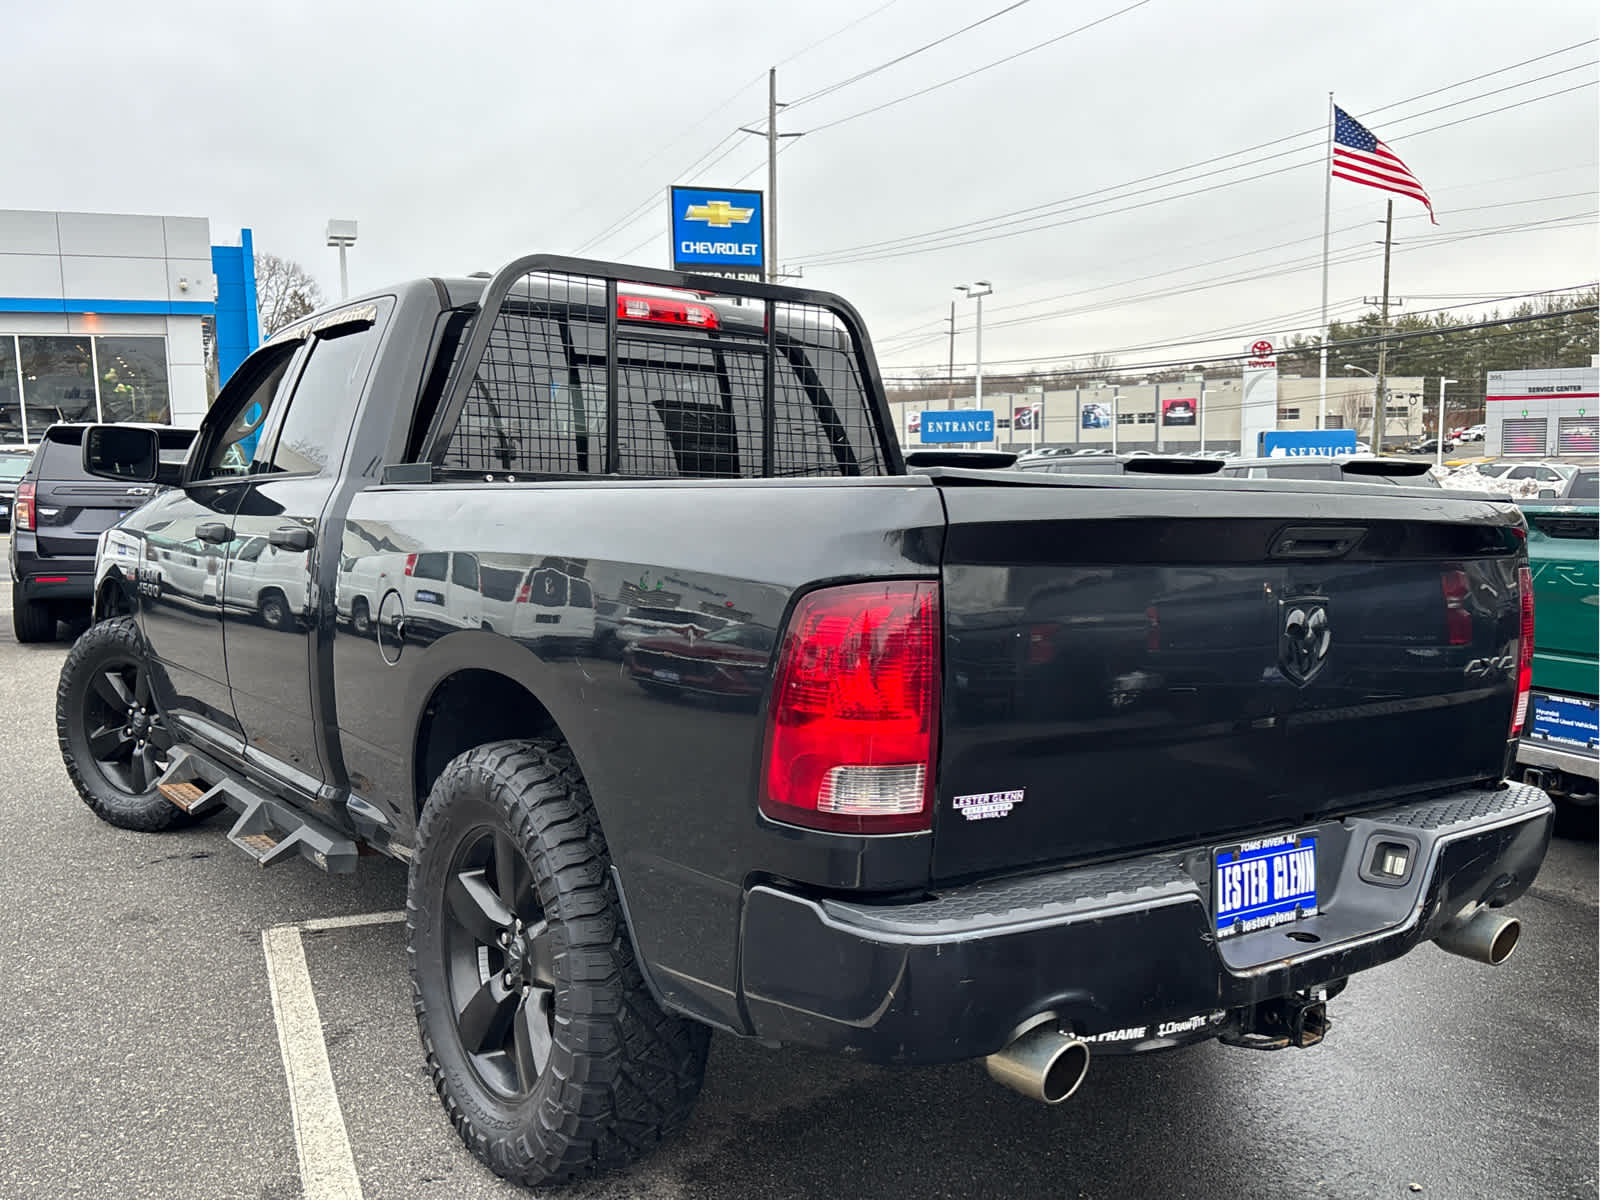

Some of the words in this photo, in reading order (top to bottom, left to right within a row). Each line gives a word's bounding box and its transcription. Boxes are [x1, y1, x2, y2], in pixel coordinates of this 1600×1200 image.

[681, 241, 759, 256] CHEVROLET
[927, 420, 991, 433] ENTRANCE
[1536, 708, 1559, 717] Hyundai
[1535, 714, 1559, 723] Certified
[1559, 718, 1574, 726] Used
[1574, 721, 1598, 730] Vehicles
[954, 794, 991, 807] LESTER
[992, 791, 1023, 803] GLENN
[1240, 839, 1261, 852] TOMS
[1286, 834, 1297, 844] NJ
[1218, 859, 1268, 913] LESTER
[1273, 849, 1315, 900] GLENN
[1098, 1026, 1147, 1042] FRAME
